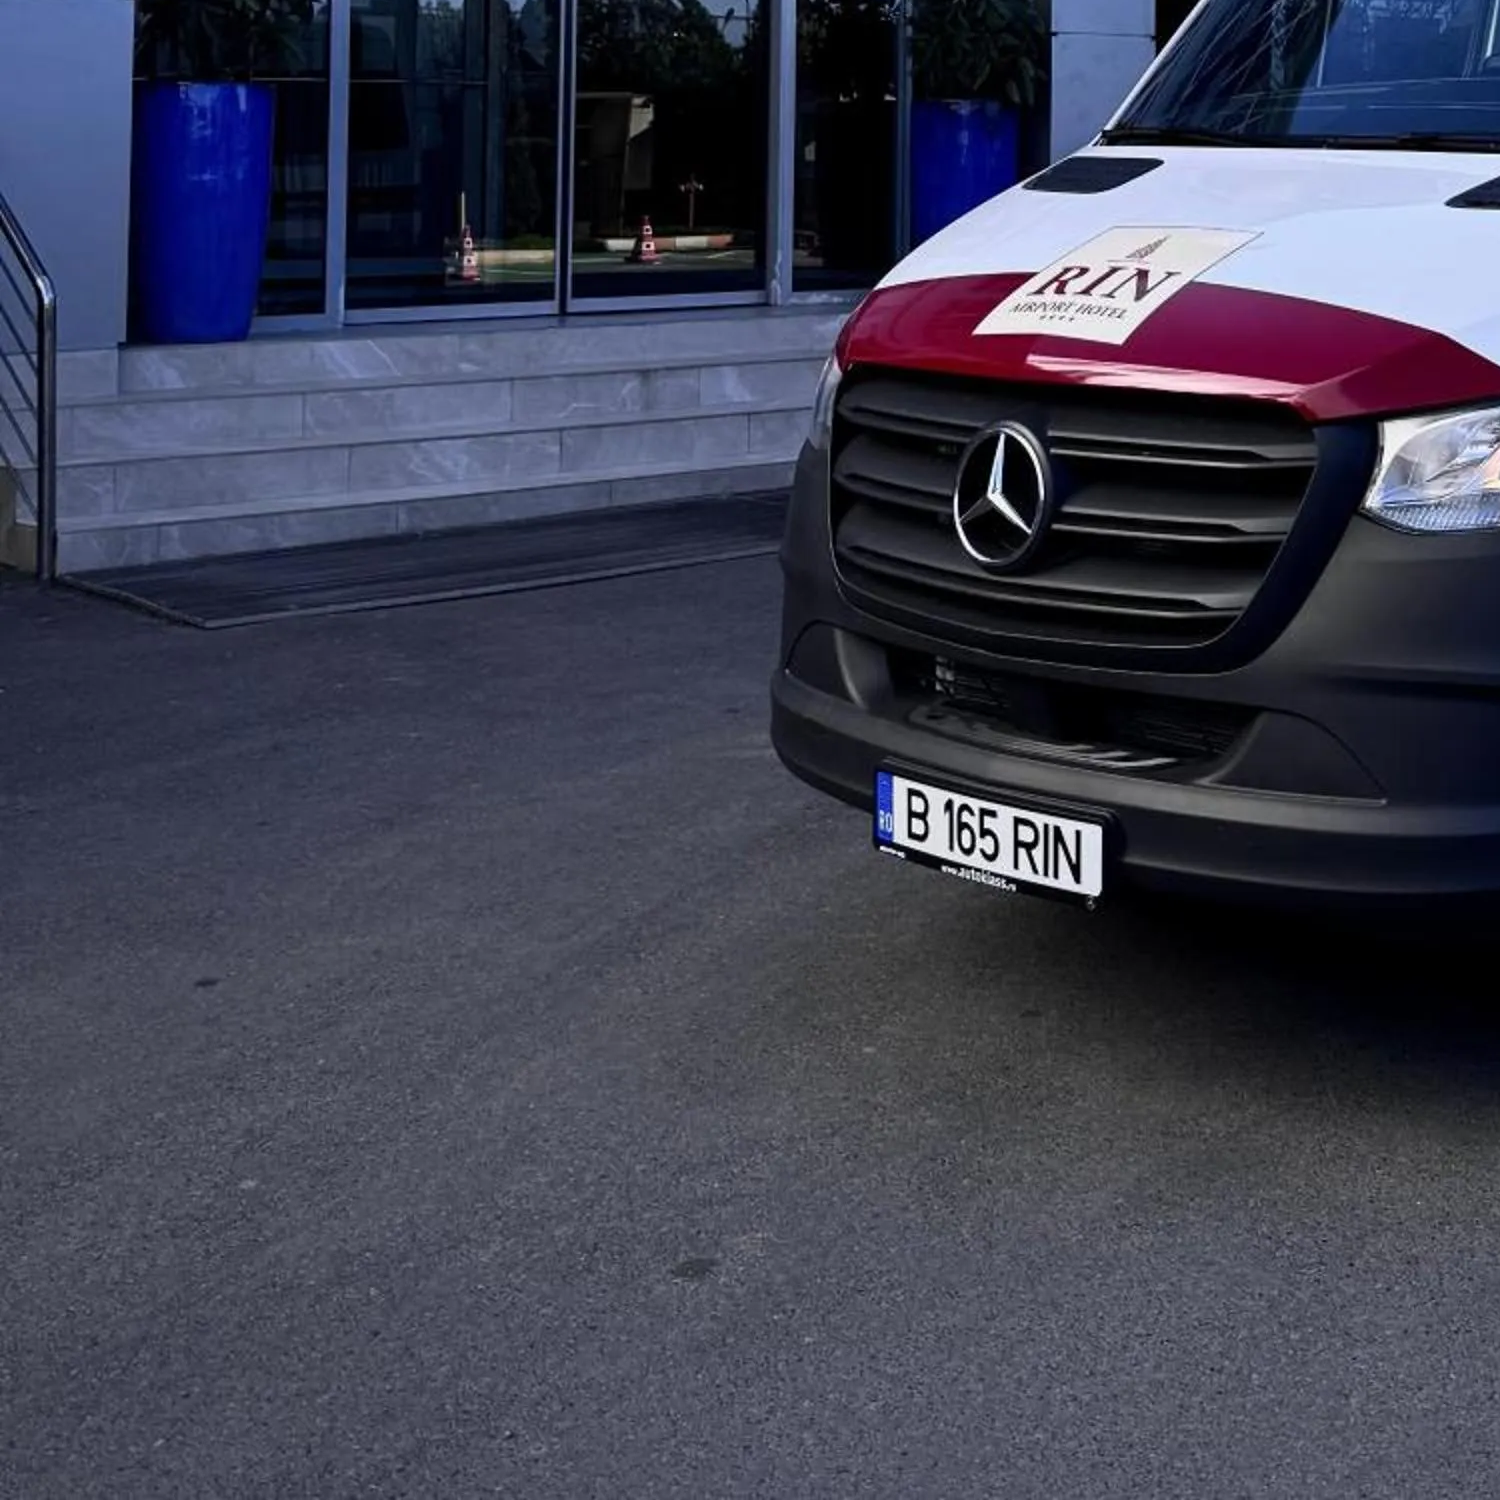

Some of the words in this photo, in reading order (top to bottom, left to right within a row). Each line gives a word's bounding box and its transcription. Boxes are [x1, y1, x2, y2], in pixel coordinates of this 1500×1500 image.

[1027, 266, 1181, 302] RIN
[1010, 300, 1074, 315] AIRPORT
[1075, 303, 1128, 319] HOTEL
[907, 787, 930, 843] B
[944, 798, 1000, 862] 165
[1013, 816, 1081, 885] RIN
